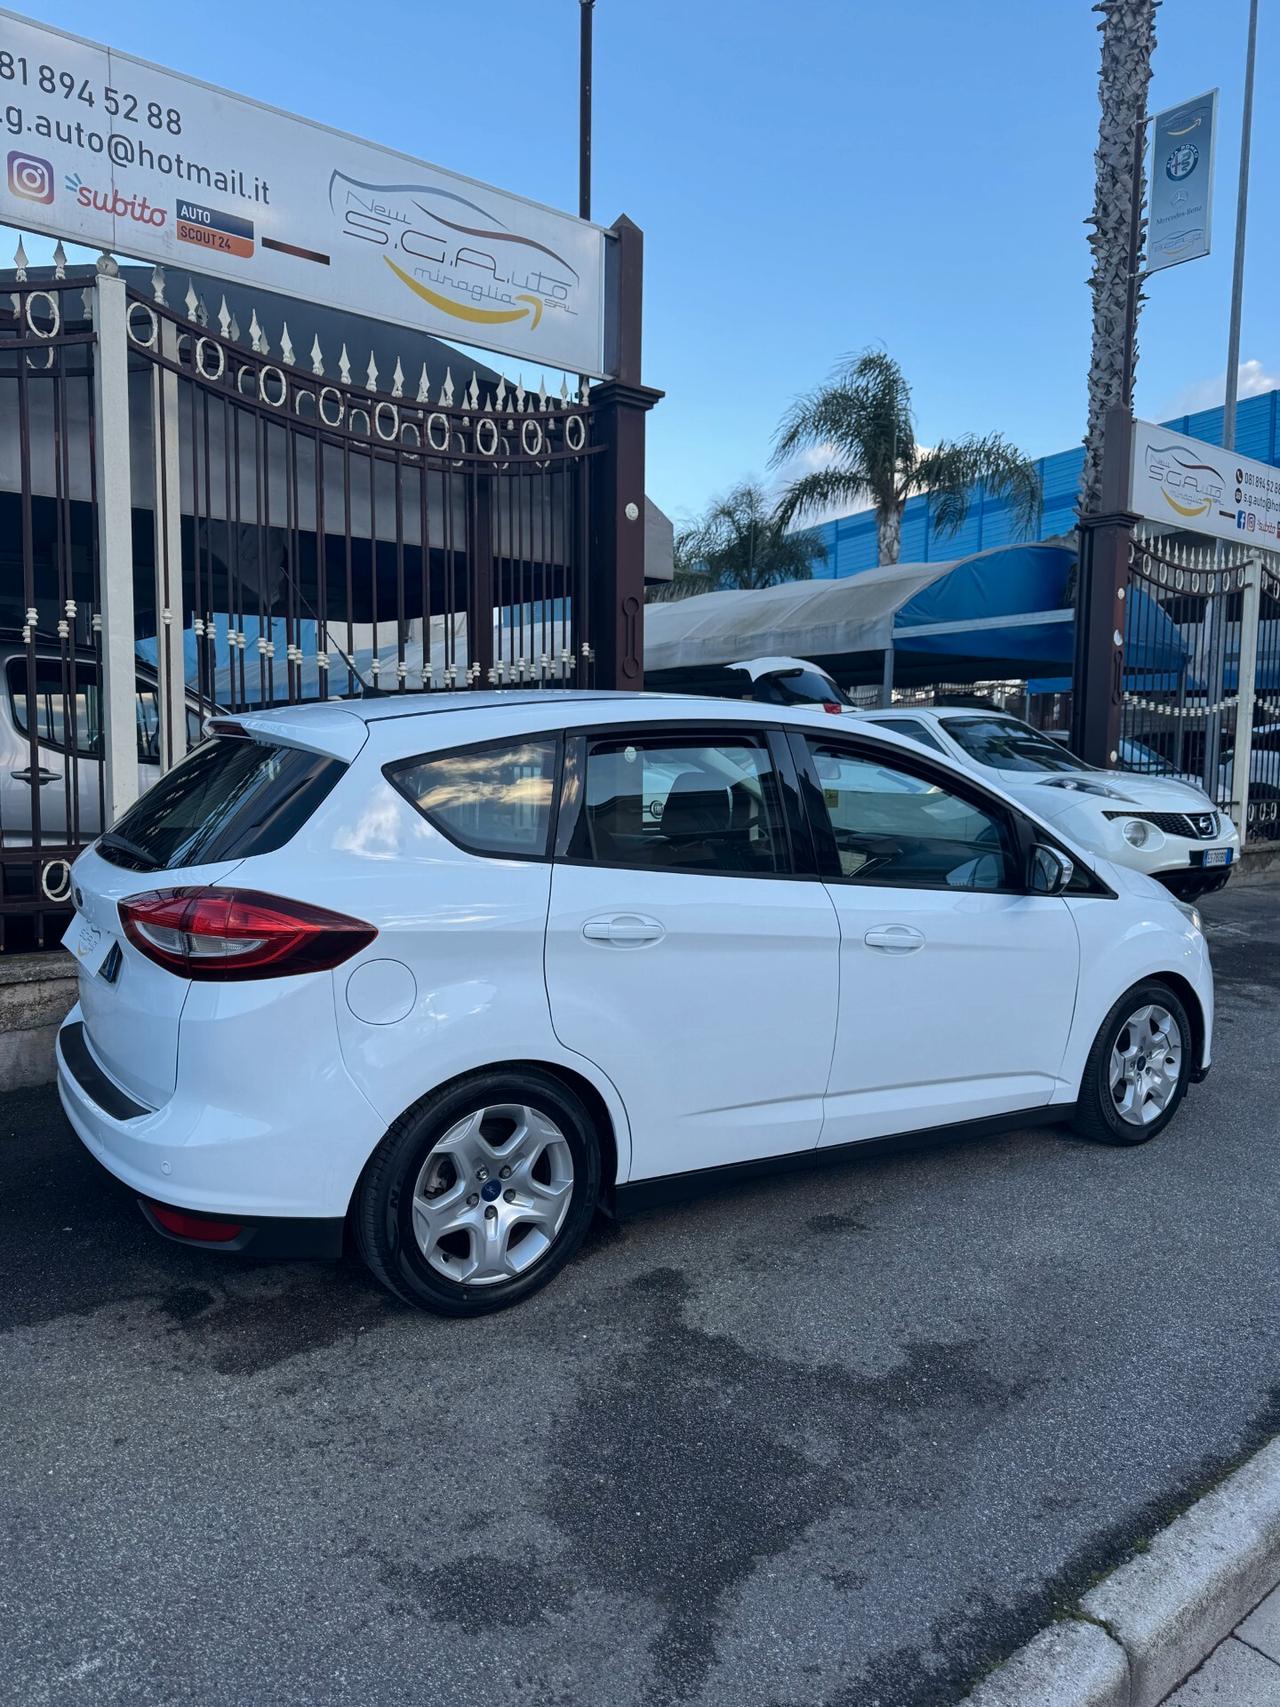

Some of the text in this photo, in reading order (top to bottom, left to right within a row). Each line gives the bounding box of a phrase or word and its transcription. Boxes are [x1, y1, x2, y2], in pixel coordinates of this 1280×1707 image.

[39, 64, 95, 108] 894
[104, 86, 139, 123] 52
[147, 102, 182, 136] 88
[77, 185, 167, 228] subito
[180, 204, 211, 224] AUTO
[345, 190, 412, 226] New
[180, 225, 231, 250] SCOUT 24
[1244, 472, 1255, 487] 081
